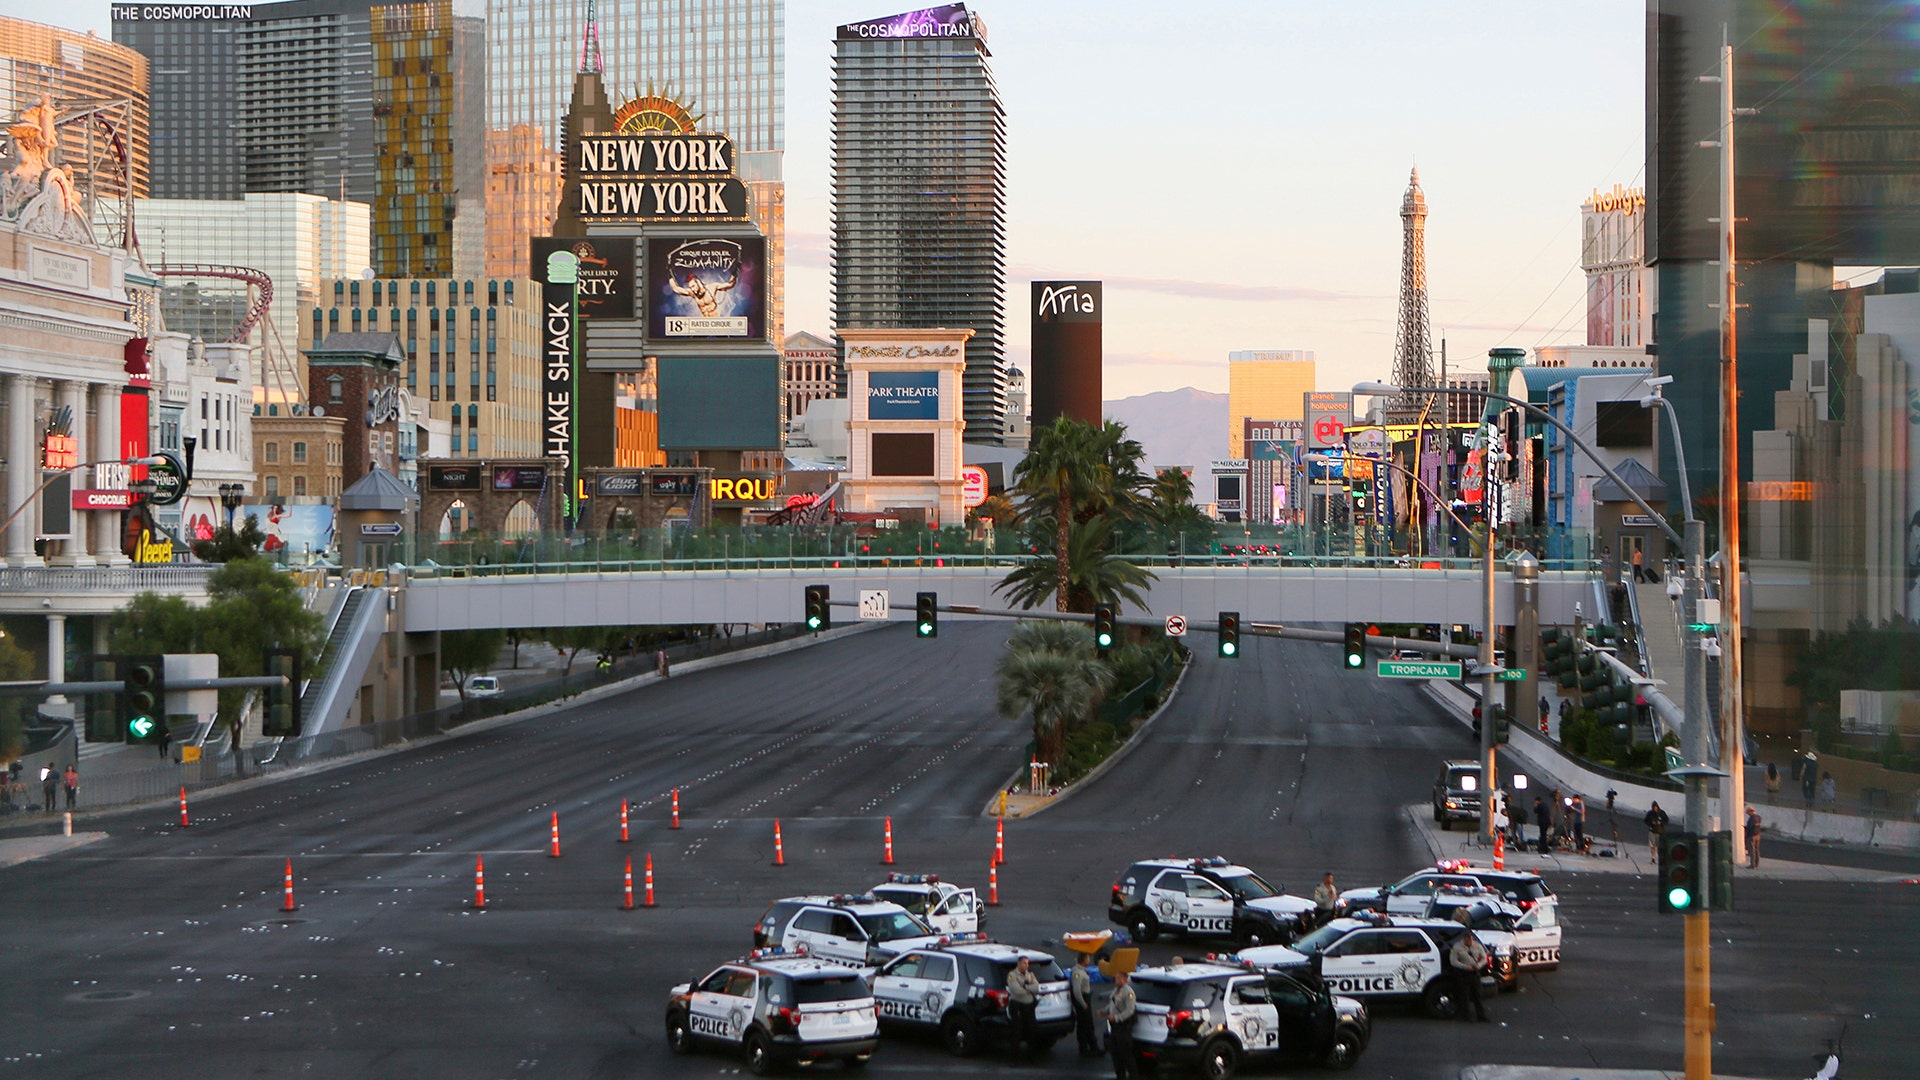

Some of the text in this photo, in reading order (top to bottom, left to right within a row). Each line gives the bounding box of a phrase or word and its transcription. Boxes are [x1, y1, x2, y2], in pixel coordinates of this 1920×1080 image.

[112, 6, 251, 21] THE COSMOPOLITAN
[846, 23, 970, 37] THE COSMOPOLITAN
[580, 139, 729, 172] NEW YORK
[580, 182, 729, 215] NEW YORK
[679, 250, 701, 258] CIRQUE
[674, 257, 736, 273] ZUMANITY
[595, 269, 609, 277] LIKE
[610, 269, 619, 277] TO
[1038, 285, 1095, 316] Aria
[691, 320, 709, 328] RATED
[711, 320, 731, 328] CIRQUE
[547, 301, 570, 382] SHACK
[848, 345, 959, 359] Monte Carlo
[1253, 352, 1291, 361] TRUMP
[869, 387, 939, 397] PARK THEATER
[1310, 393, 1335, 401] planet
[1310, 402, 1348, 412] hollywood
[1220, 460, 1247, 468] MIRAGE
[88, 494, 127, 505] CHOCOLATE
[135, 528, 173, 563] Reese's
[1390, 664, 1449, 676] TROPICANA
[1506, 671, 1522, 679] 100
[1180, 912, 1234, 931] POLICE
[1327, 977, 1395, 992] POLICE
[875, 998, 923, 1020] POLICE
[691, 1016, 729, 1037] POLICE
[1265, 1032, 1277, 1046] P
